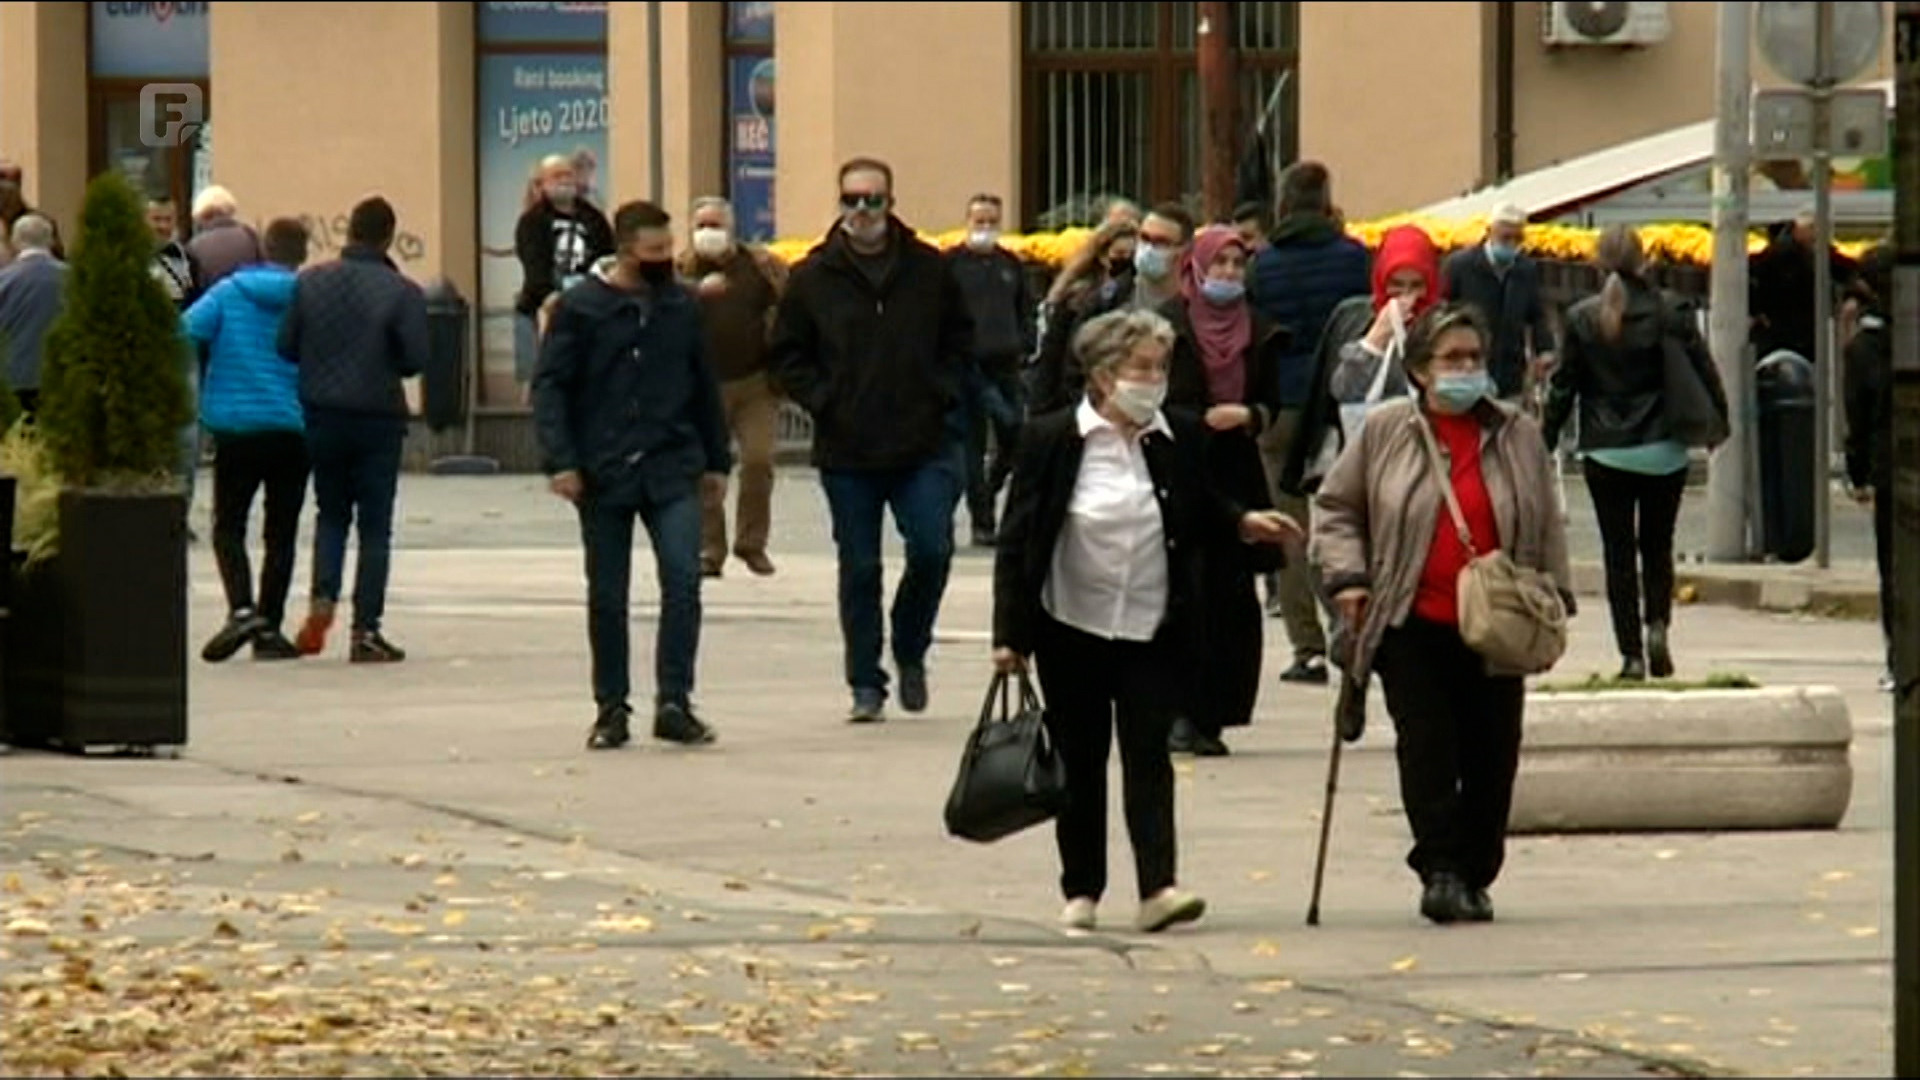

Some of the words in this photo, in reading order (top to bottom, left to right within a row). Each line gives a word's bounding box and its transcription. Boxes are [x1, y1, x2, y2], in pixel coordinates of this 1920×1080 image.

[514, 66, 545, 87] Rani
[548, 67, 604, 90] booking
[498, 106, 553, 147] Ljeto
[558, 97, 610, 132] 2020
